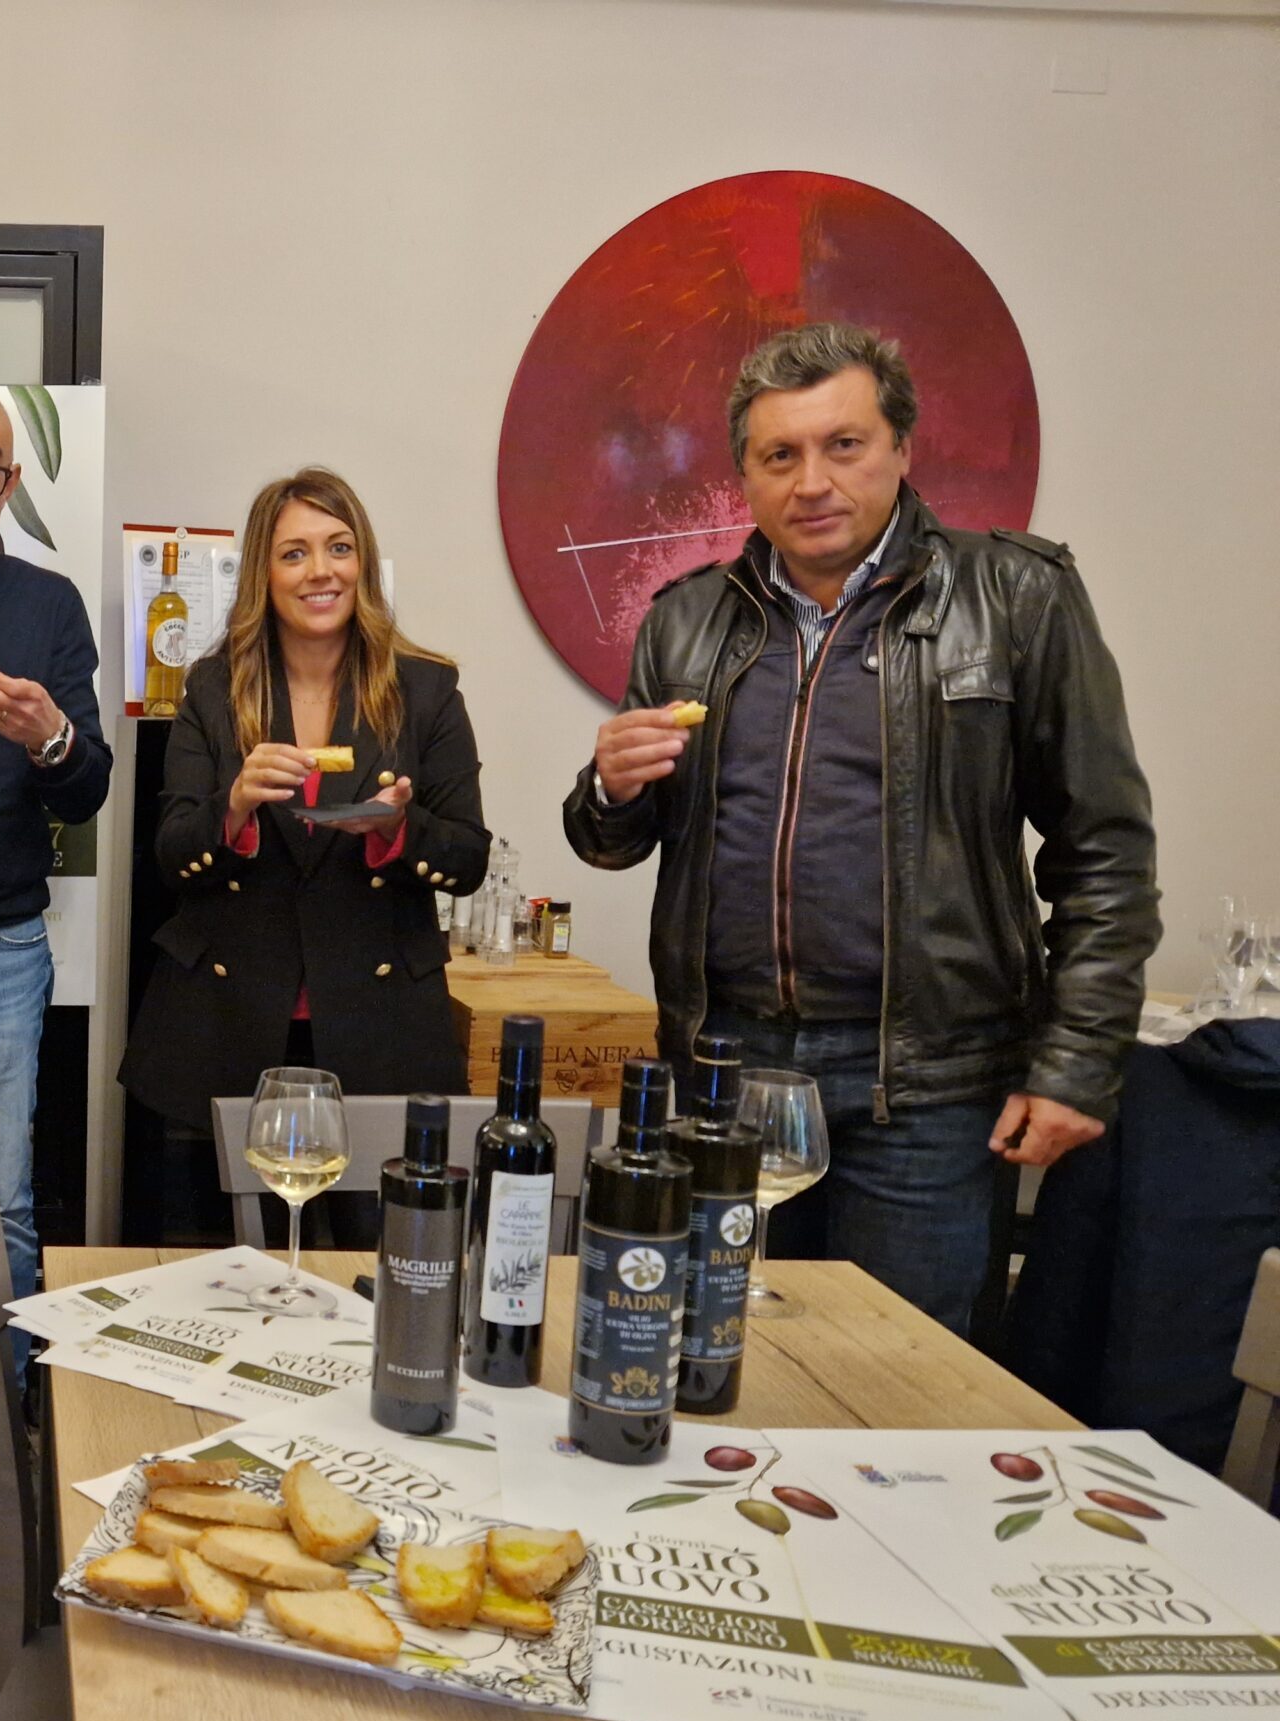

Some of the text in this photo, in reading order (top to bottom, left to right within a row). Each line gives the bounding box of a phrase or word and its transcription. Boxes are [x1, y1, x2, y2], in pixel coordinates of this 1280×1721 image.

[583, 1047, 646, 1064] NERA
[387, 1253, 455, 1275] MAGRILLE
[607, 1290, 672, 1312] BADINI
[136, 1319, 226, 1348] NUOVO
[307, 1355, 372, 1378] OLIO
[342, 1450, 442, 1500] OLIO
[624, 1541, 761, 1579] OLIO
[1038, 1573, 1175, 1598] OLIO
[601, 1596, 780, 1635] CASTIGLION
[1007, 1600, 1213, 1627] NUOVO
[599, 1608, 788, 1650] FIORENTINO
[1085, 1639, 1258, 1656] CASTIGLION
[852, 1649, 985, 1679] NOVEMBRE
[1094, 1655, 1279, 1672] FIORENTINO
[1091, 1689, 1280, 1709] DEGUSTAZI
